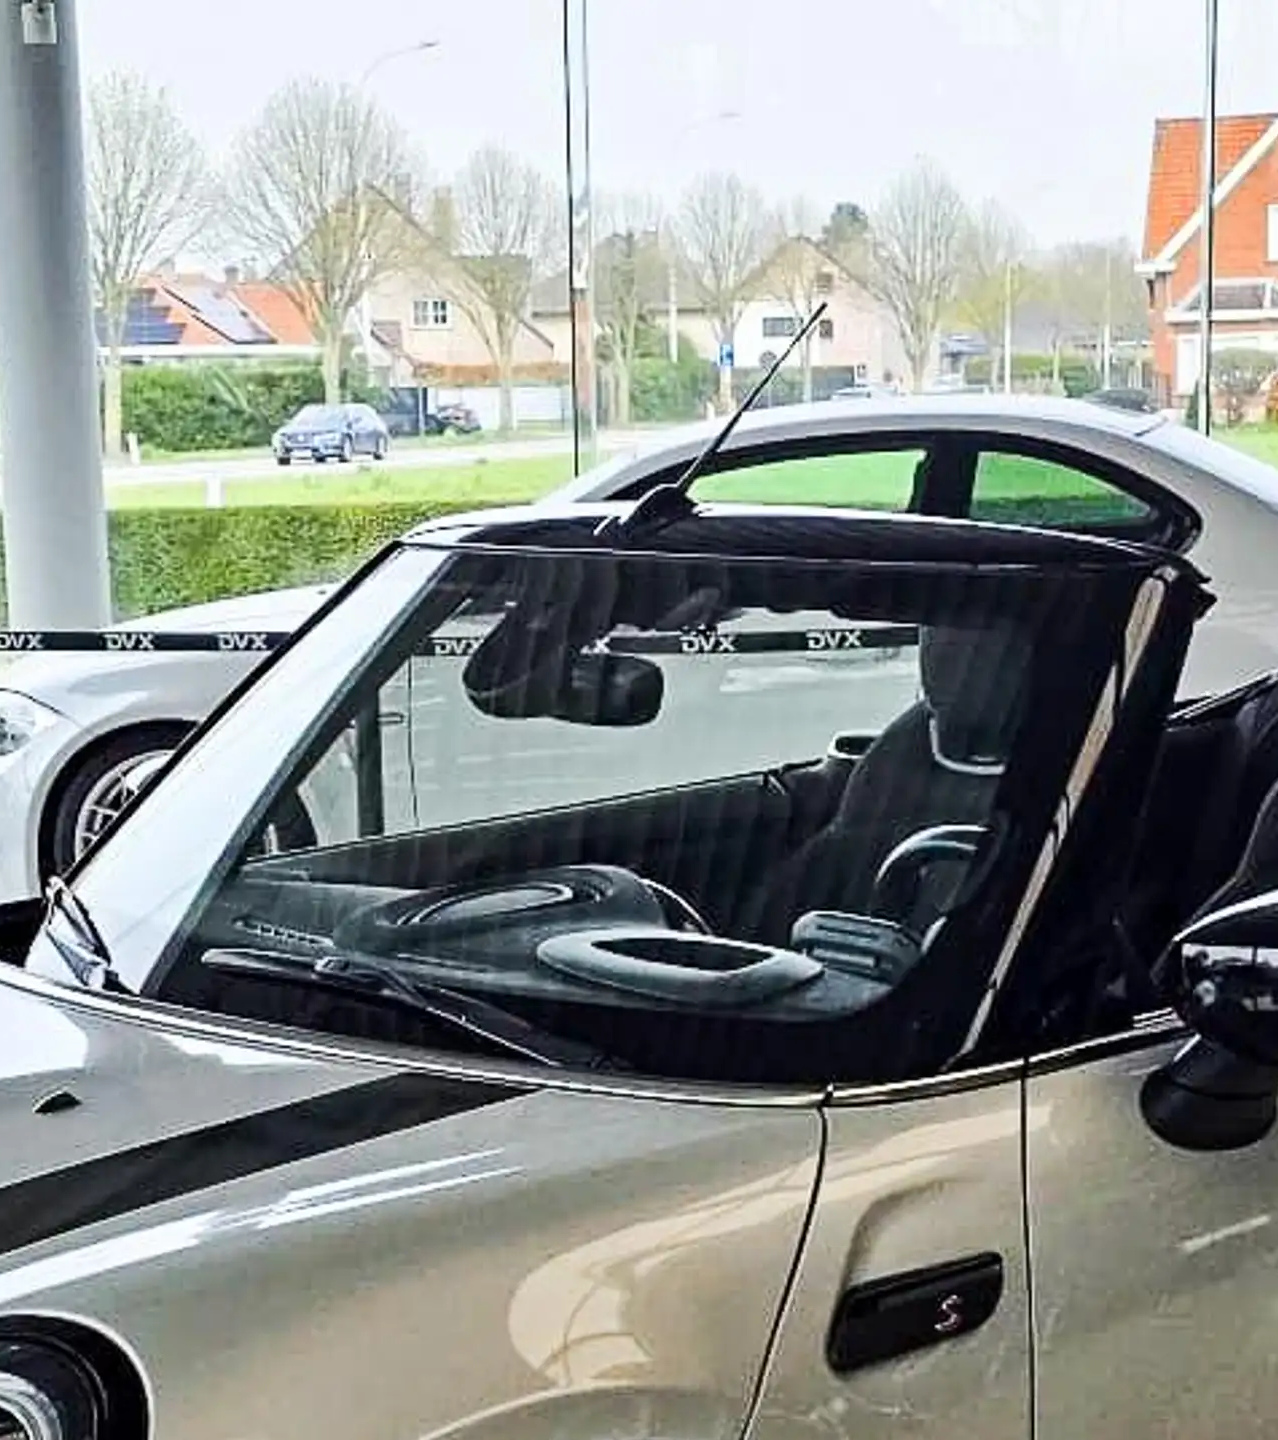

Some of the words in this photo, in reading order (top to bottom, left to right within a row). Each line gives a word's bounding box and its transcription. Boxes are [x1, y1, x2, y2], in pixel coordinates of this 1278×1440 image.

[103, 633, 155, 649] DVX
[218, 633, 268, 649] DVX
[679, 632, 737, 652] DVX
[806, 630, 862, 649] DVX
